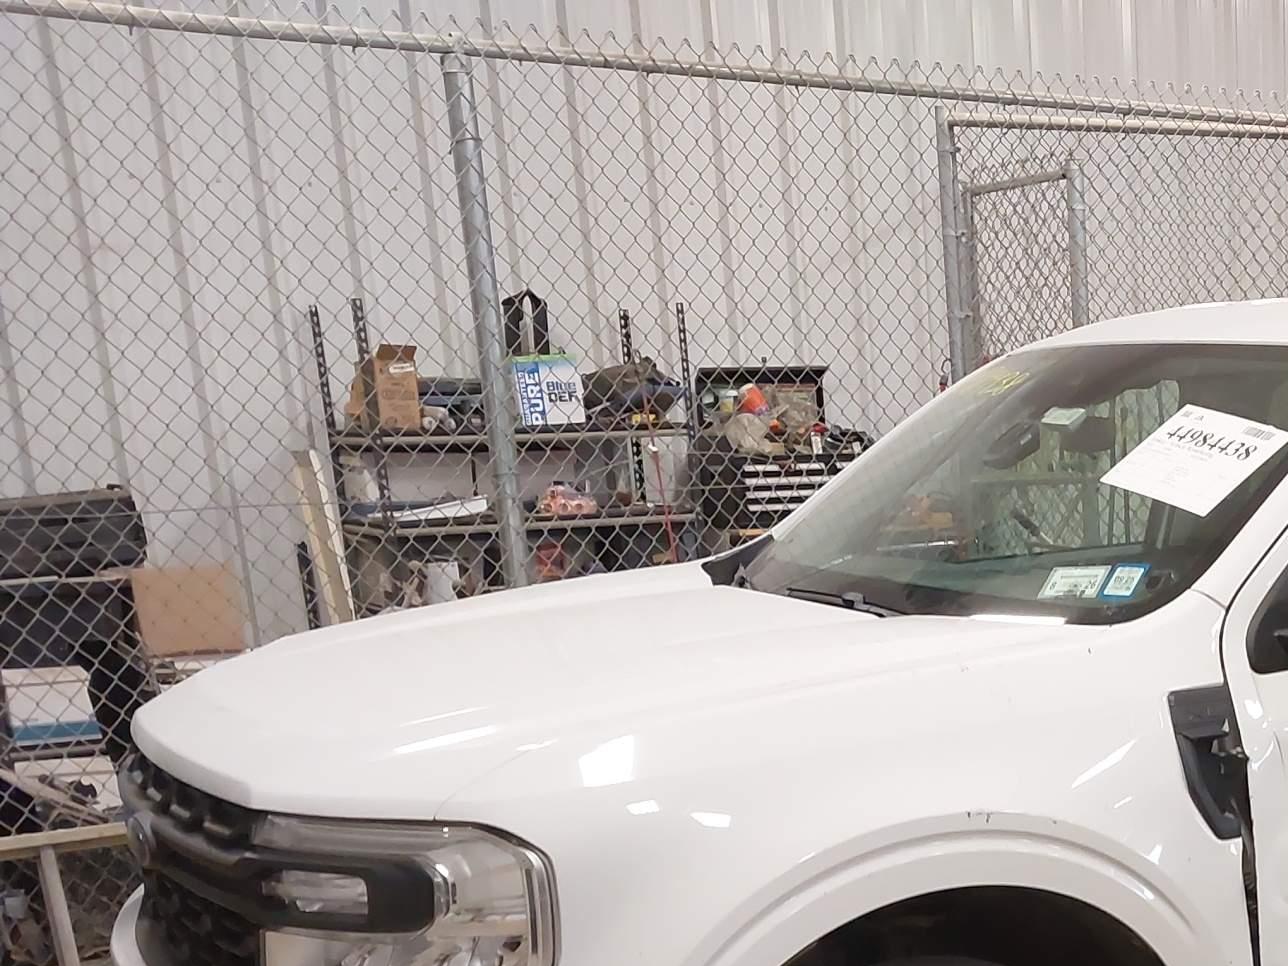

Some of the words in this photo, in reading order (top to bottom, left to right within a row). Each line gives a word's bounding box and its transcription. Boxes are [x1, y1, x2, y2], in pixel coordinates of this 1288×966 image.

[525, 371, 545, 426] PURE
[547, 391, 577, 403] DEF
[1167, 425, 1258, 461] 44984438
